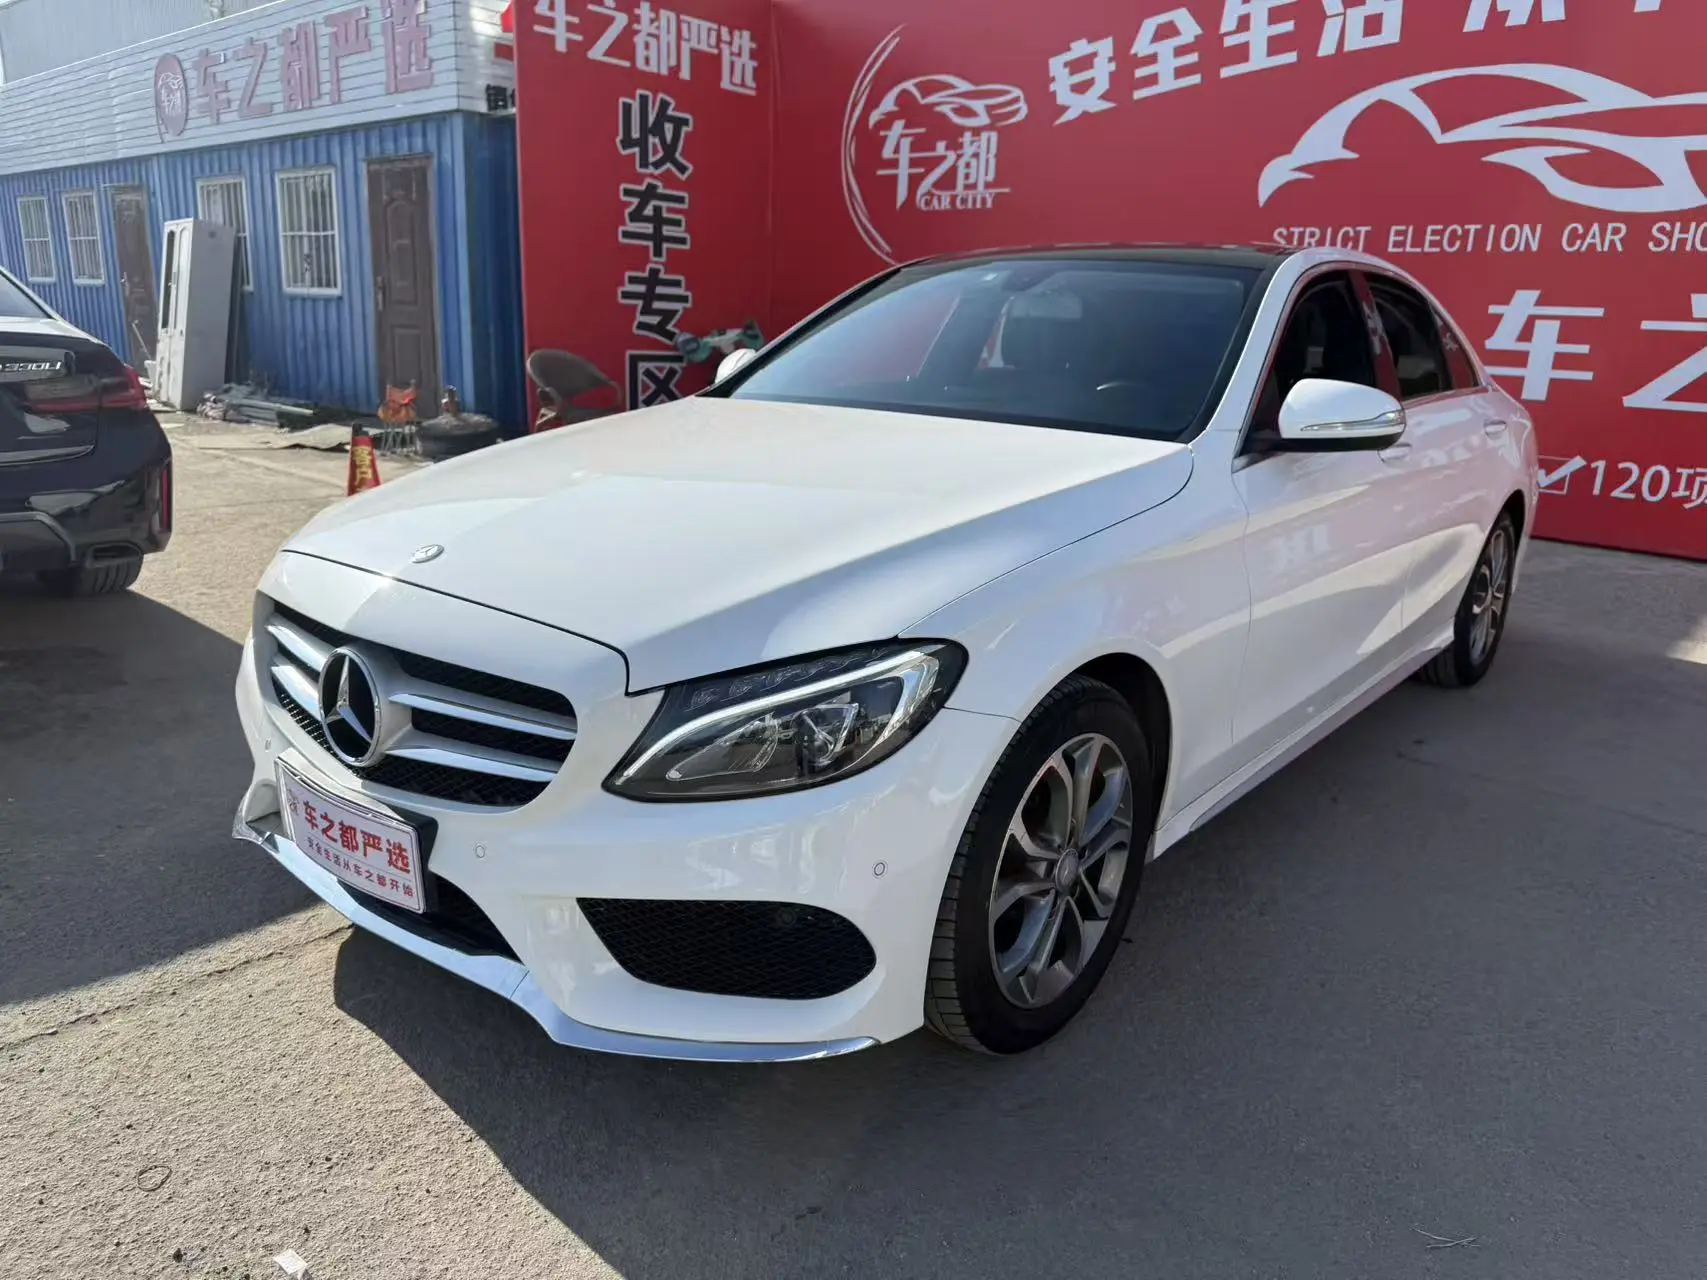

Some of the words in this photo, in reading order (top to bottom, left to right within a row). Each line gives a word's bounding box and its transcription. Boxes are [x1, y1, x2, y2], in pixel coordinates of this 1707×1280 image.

[193, 0, 434, 124] 车之都严选
[533, 0, 758, 96] 车之都严选
[1048, 0, 1403, 127] 安全生活
[876, 119, 1011, 211] 车之都
[920, 193, 951, 211] CAR
[956, 191, 997, 209] CITY
[616, 89, 693, 411] 收车专区
[1273, 226, 1371, 252] STRICT
[1388, 223, 1542, 252] ELECTION
[1561, 222, 1627, 252] CAR
[1590, 459, 1707, 509] 120项
[303, 801, 411, 874] 车之都严选
